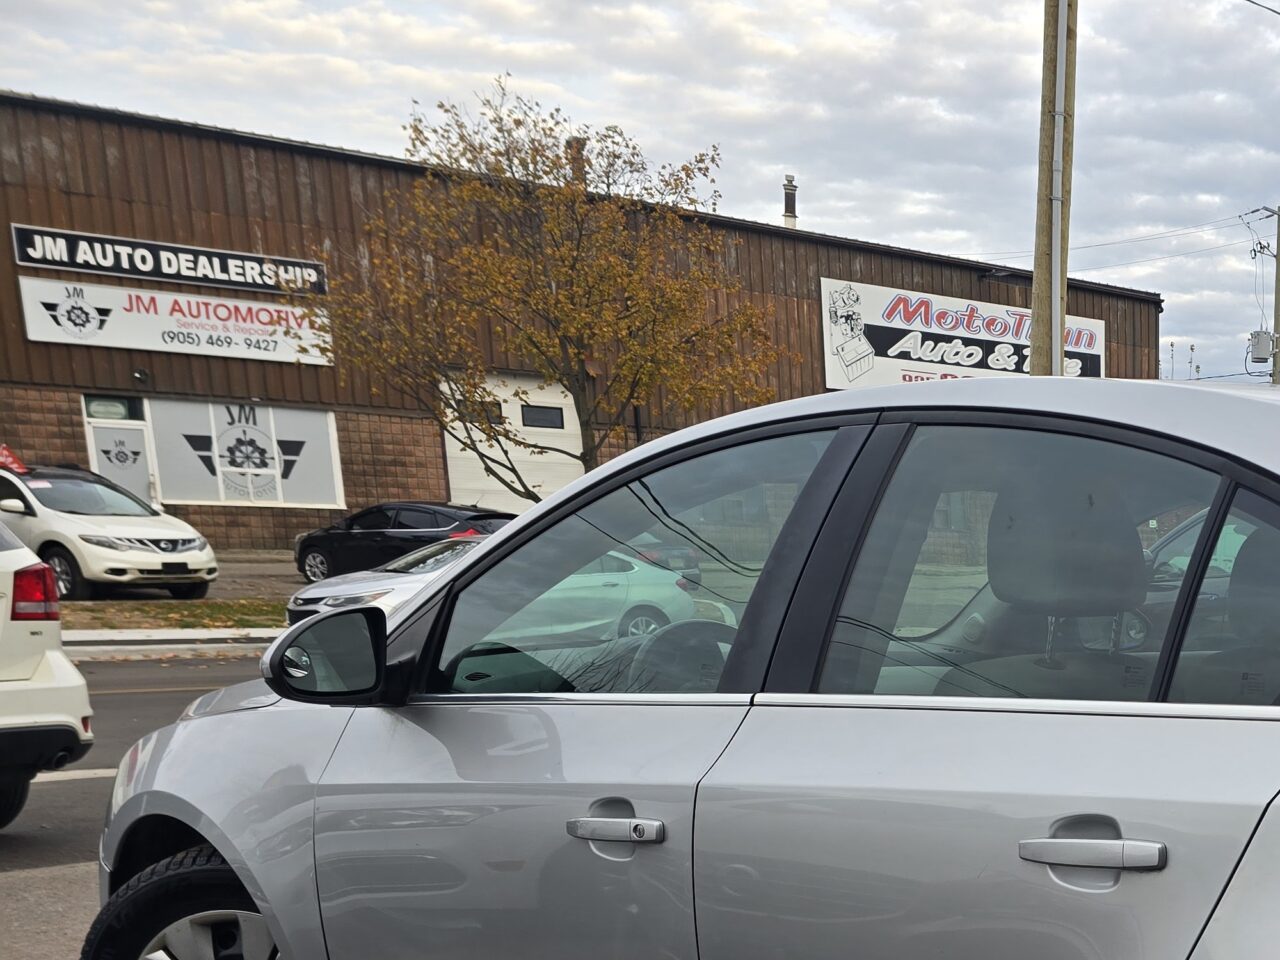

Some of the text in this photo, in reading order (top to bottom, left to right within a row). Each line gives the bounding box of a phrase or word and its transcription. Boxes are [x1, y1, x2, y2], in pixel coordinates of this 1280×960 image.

[26, 234, 318, 289] JM AUTO DEALERSHIP
[65, 286, 84, 299] JM
[122, 293, 321, 329] JM AUTOMOTIV
[881, 293, 1097, 350] MotoTn
[161, 330, 201, 347] (905)
[244, 337, 278, 353] 9427
[175, 319, 270, 337] Service & Repair
[887, 331, 983, 366] Auto
[987, 343, 1019, 371] &
[225, 404, 258, 427] JM
